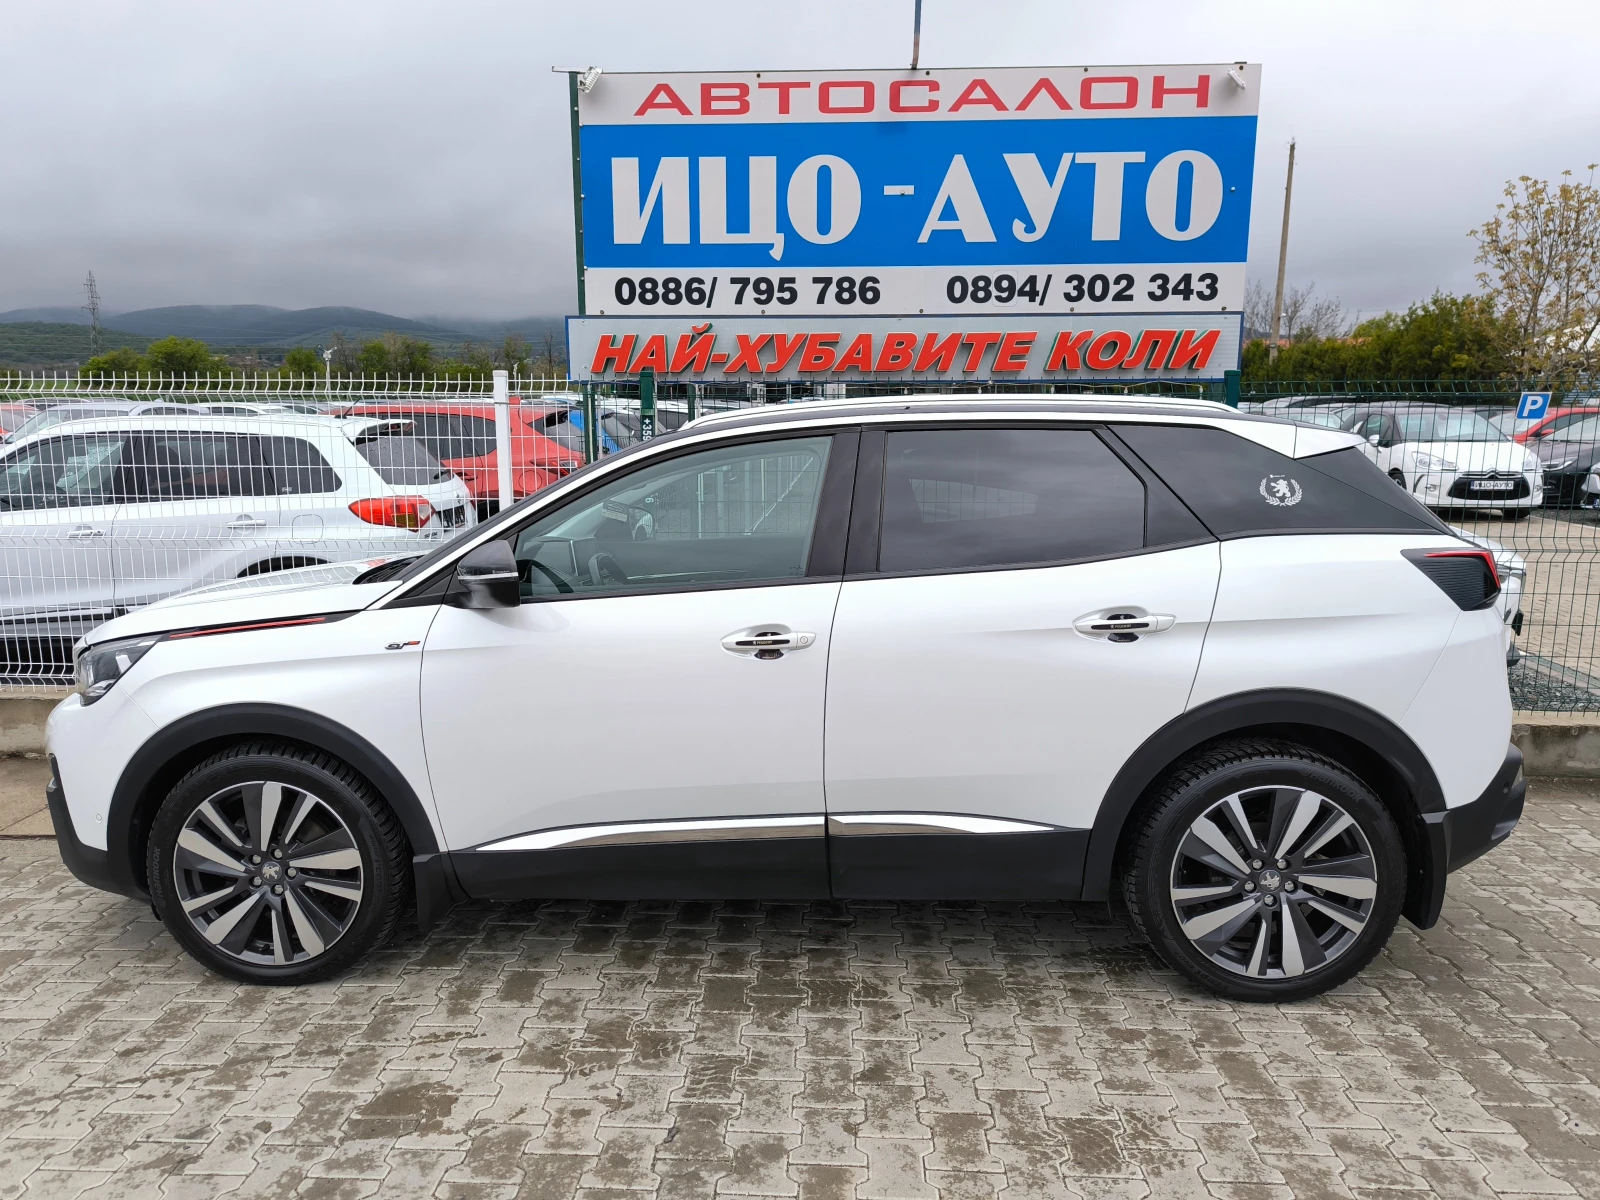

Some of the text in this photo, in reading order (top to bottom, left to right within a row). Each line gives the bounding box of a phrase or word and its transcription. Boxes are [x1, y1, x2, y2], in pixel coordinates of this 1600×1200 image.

[633, 74, 1210, 116] АВТОСАЛОН
[614, 276, 881, 308] 0886/ 795 786
[946, 272, 1219, 306] 0894/ 302 343
[590, 322, 1222, 374] НАЙ-ХУБАВИТЕ КОЛИ
[1522, 395, 1543, 417] P
